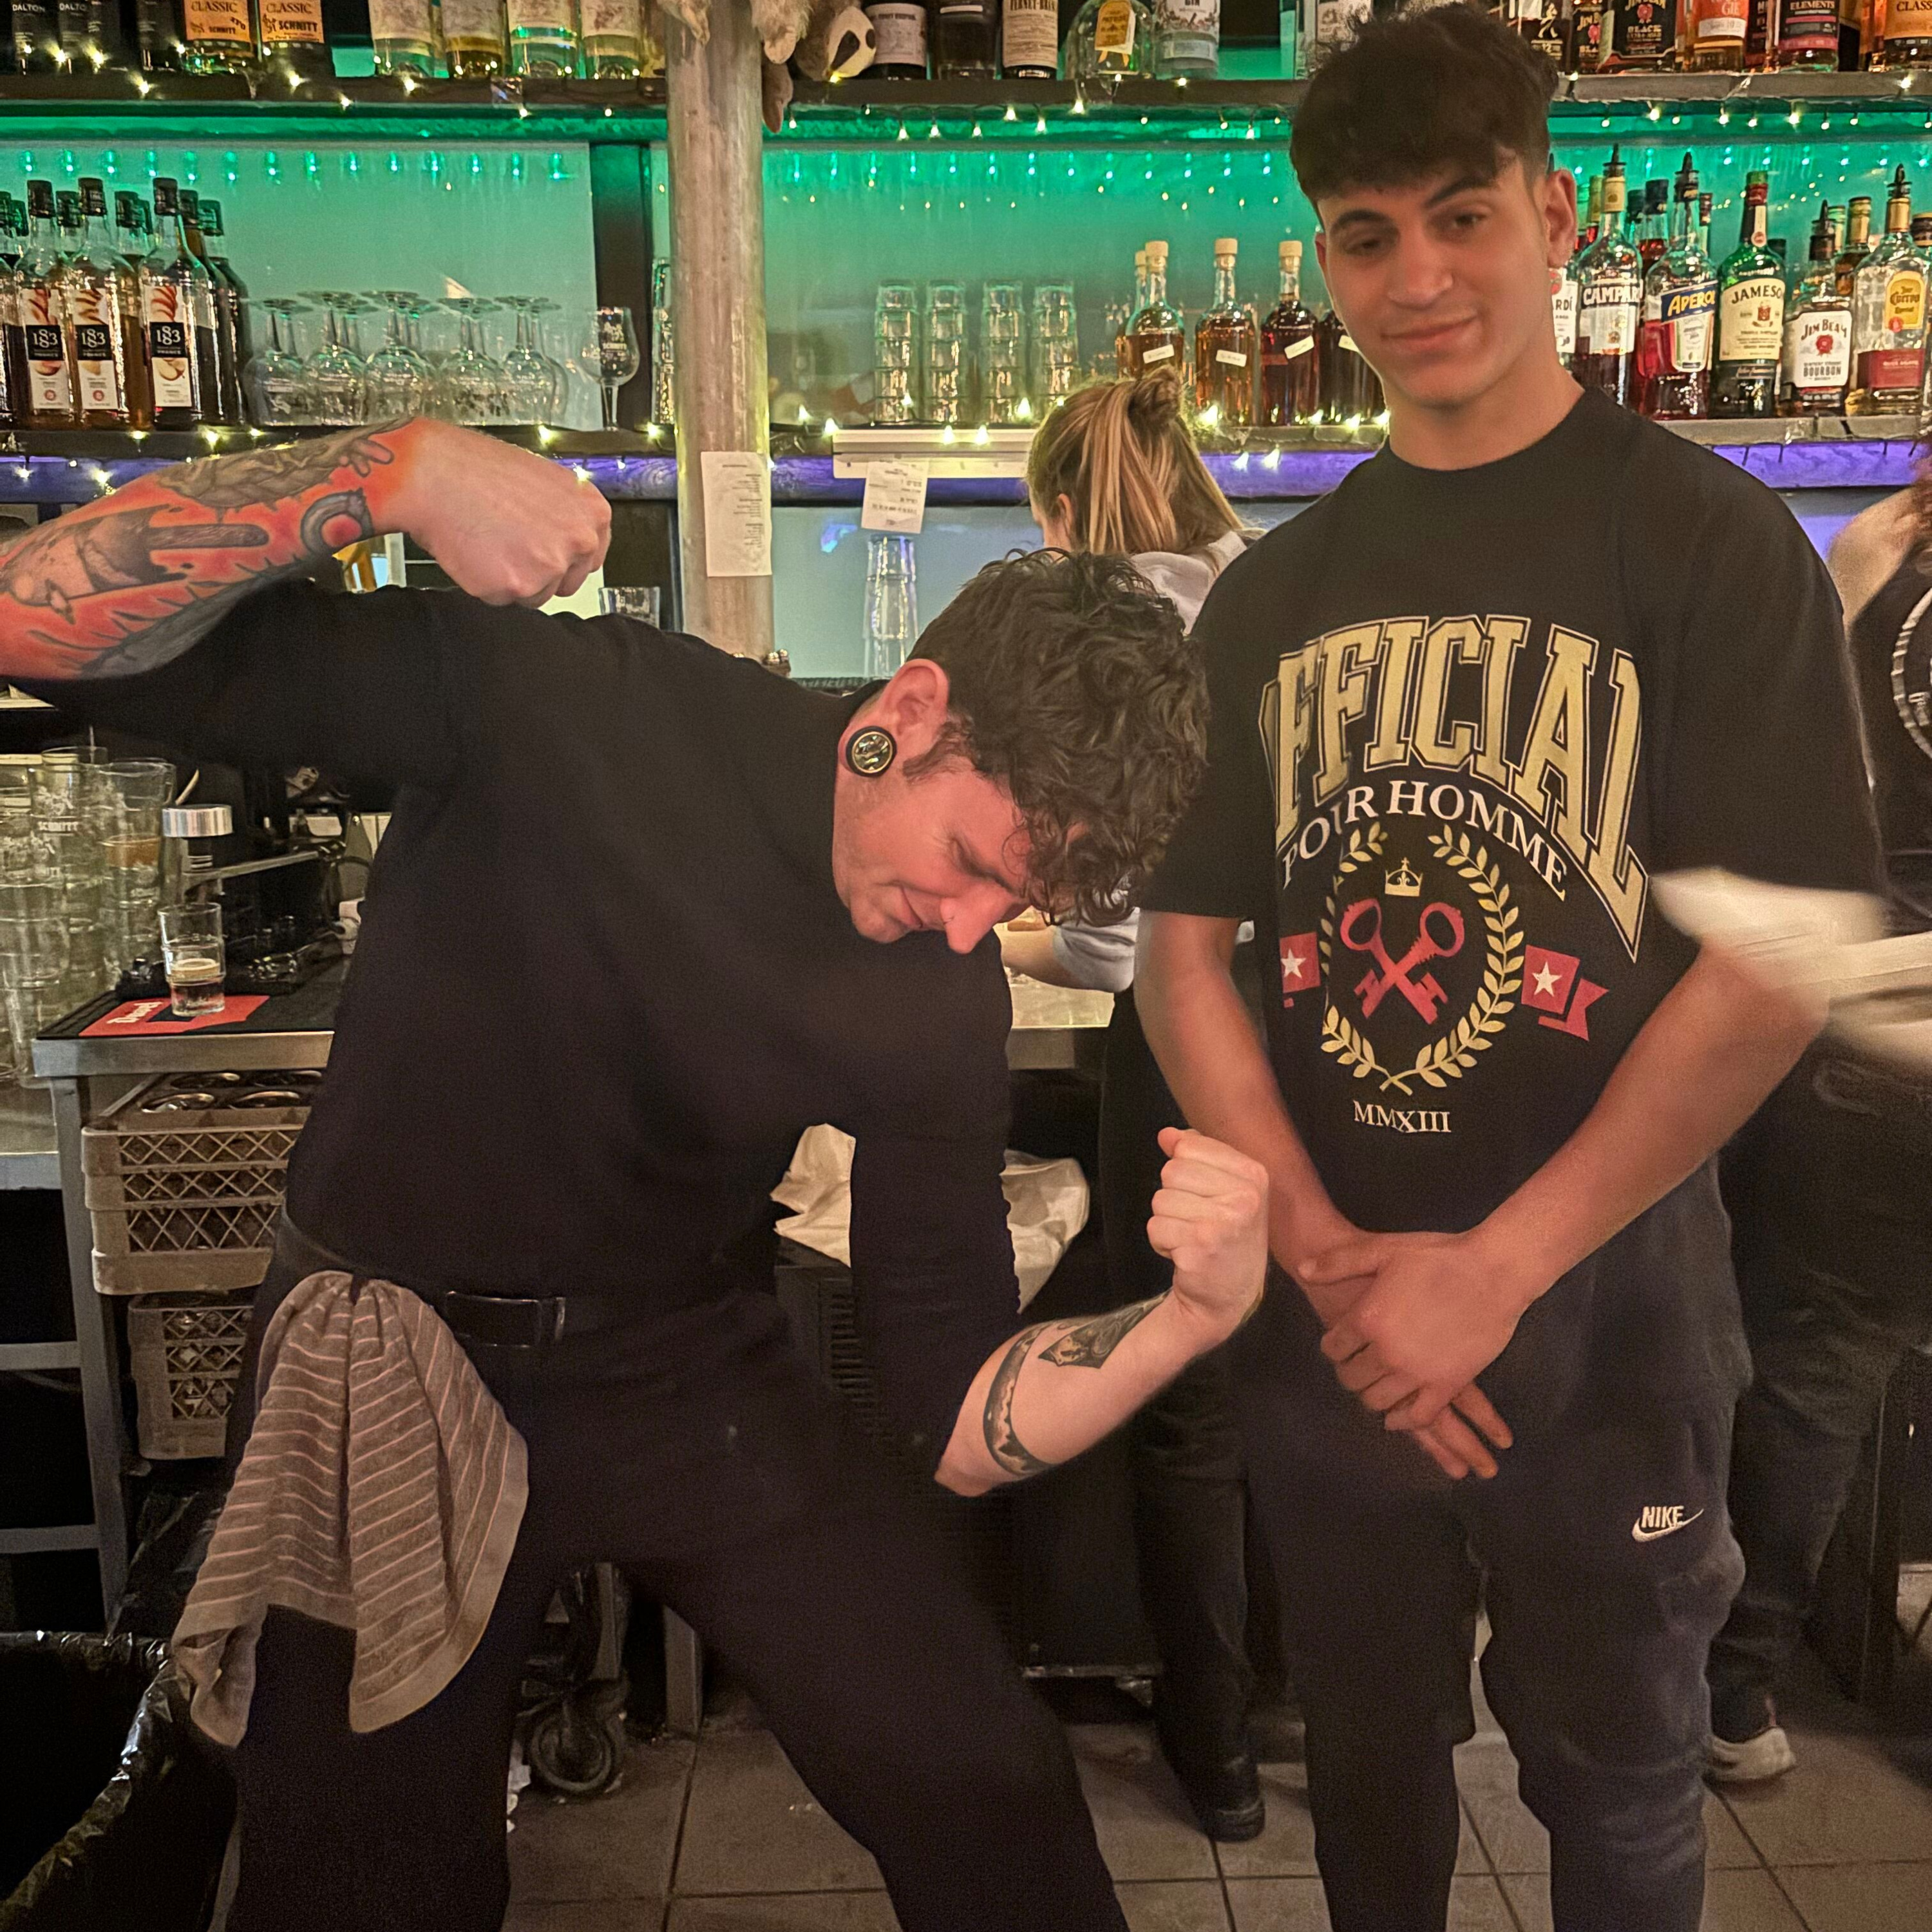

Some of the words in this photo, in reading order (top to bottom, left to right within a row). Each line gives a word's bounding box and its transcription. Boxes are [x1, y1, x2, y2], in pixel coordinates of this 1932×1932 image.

[191, 2, 238, 13] CLASSIC
[266, 3, 312, 14] CLASSIC
[1583, 286, 1640, 305] CAMPAR
[1731, 285, 1782, 304] JAMESO
[1803, 366, 1841, 377] BOURBON
[1258, 614, 1648, 963] FFICIAL
[1386, 780, 1567, 902] HOMME
[1353, 1100, 1452, 1133] MMXIII
[1642, 1506, 1684, 1528] NIKE
